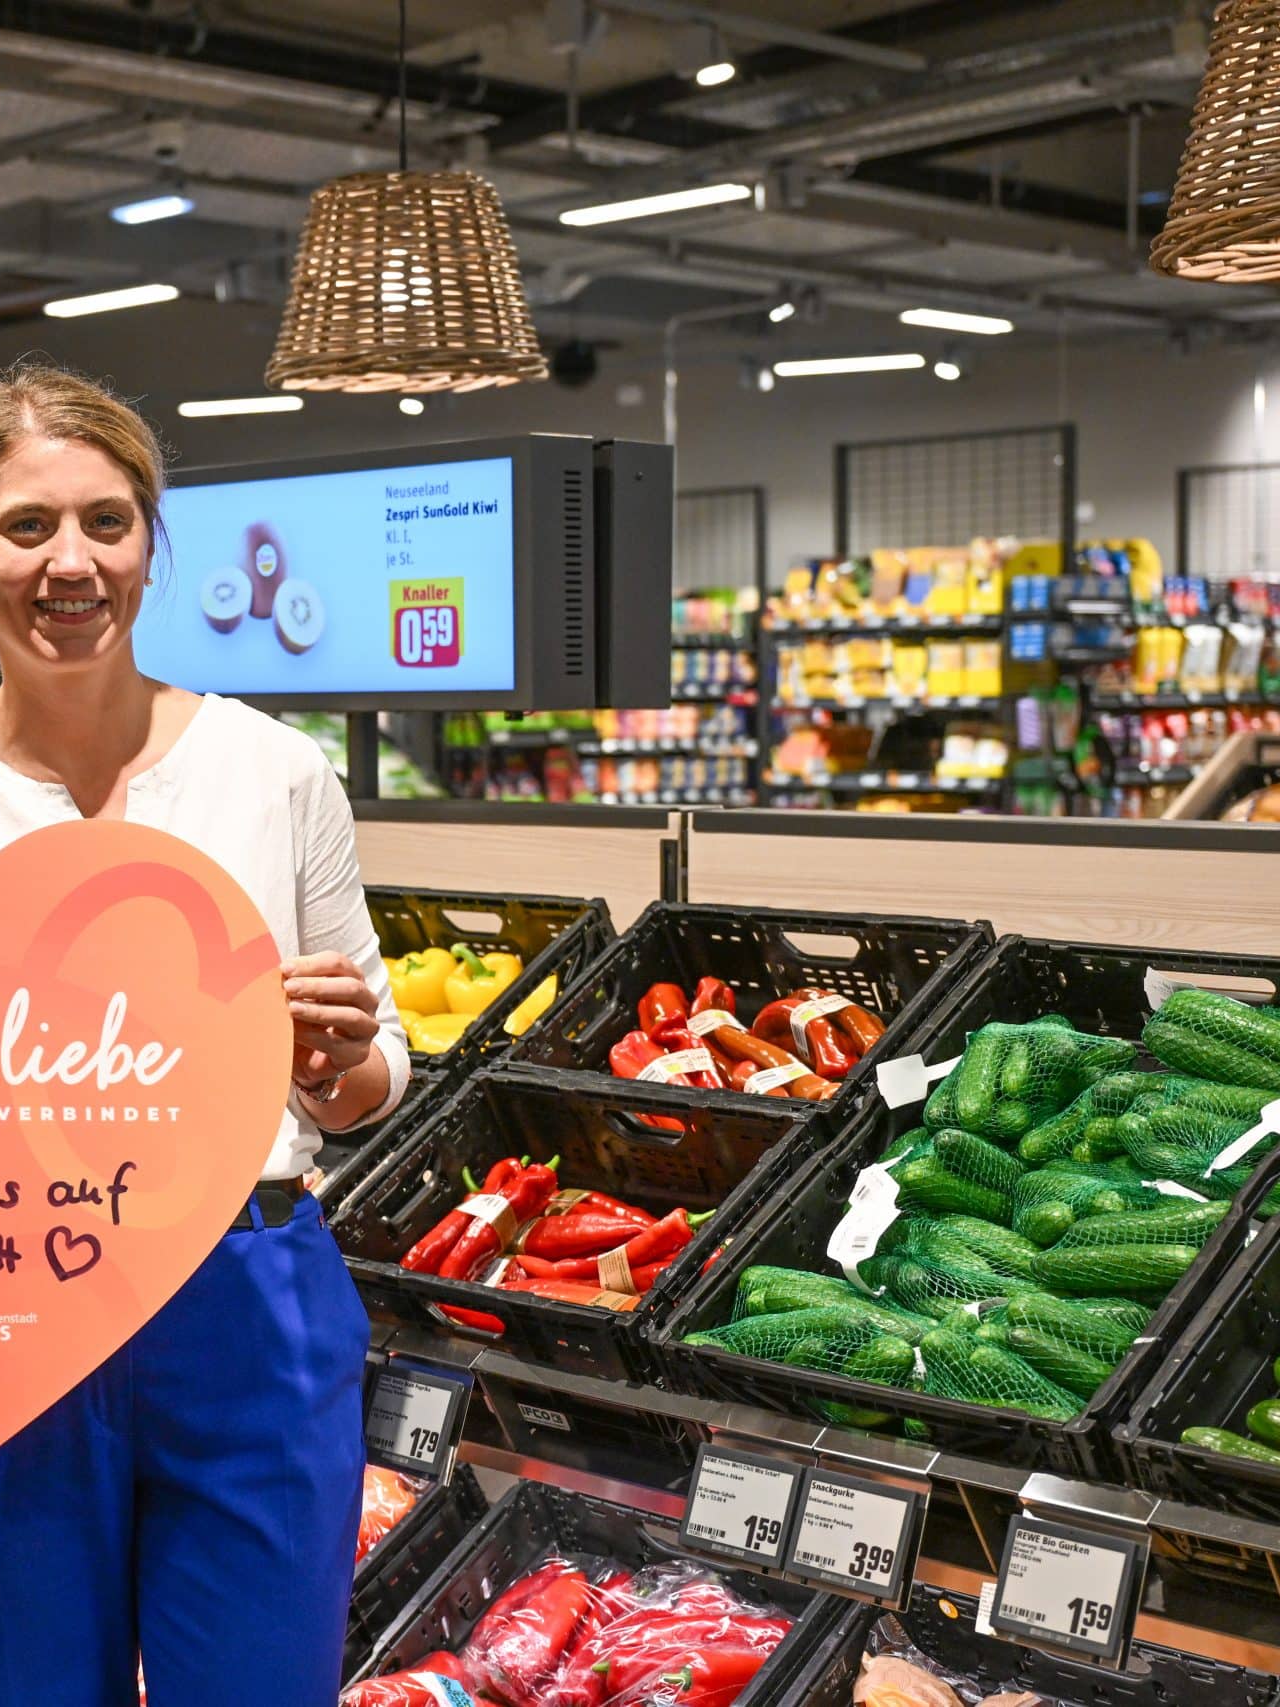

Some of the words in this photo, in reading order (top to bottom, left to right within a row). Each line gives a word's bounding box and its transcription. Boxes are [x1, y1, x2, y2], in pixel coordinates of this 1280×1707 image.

[385, 480, 449, 499] Neuseeland
[385, 506, 419, 523] Zespri
[423, 502, 469, 519] SunGold
[472, 499, 498, 515] Kiwi
[386, 551, 396, 569] je
[400, 551, 414, 566] St.
[403, 584, 449, 602] Knaller
[400, 607, 454, 663] 0.59
[47, 1161, 137, 1225] auf
[522, 1406, 550, 1420] IFCO
[410, 1427, 439, 1458] 1.79
[811, 1481, 855, 1499] Snackgurke
[744, 1515, 781, 1550] 1.59
[1016, 1531, 1040, 1543] REWE
[1042, 1537, 1056, 1547] Bio
[1059, 1540, 1090, 1555] Gurken
[849, 1542, 894, 1579] 3.99
[1067, 1597, 1113, 1636] 1.59
